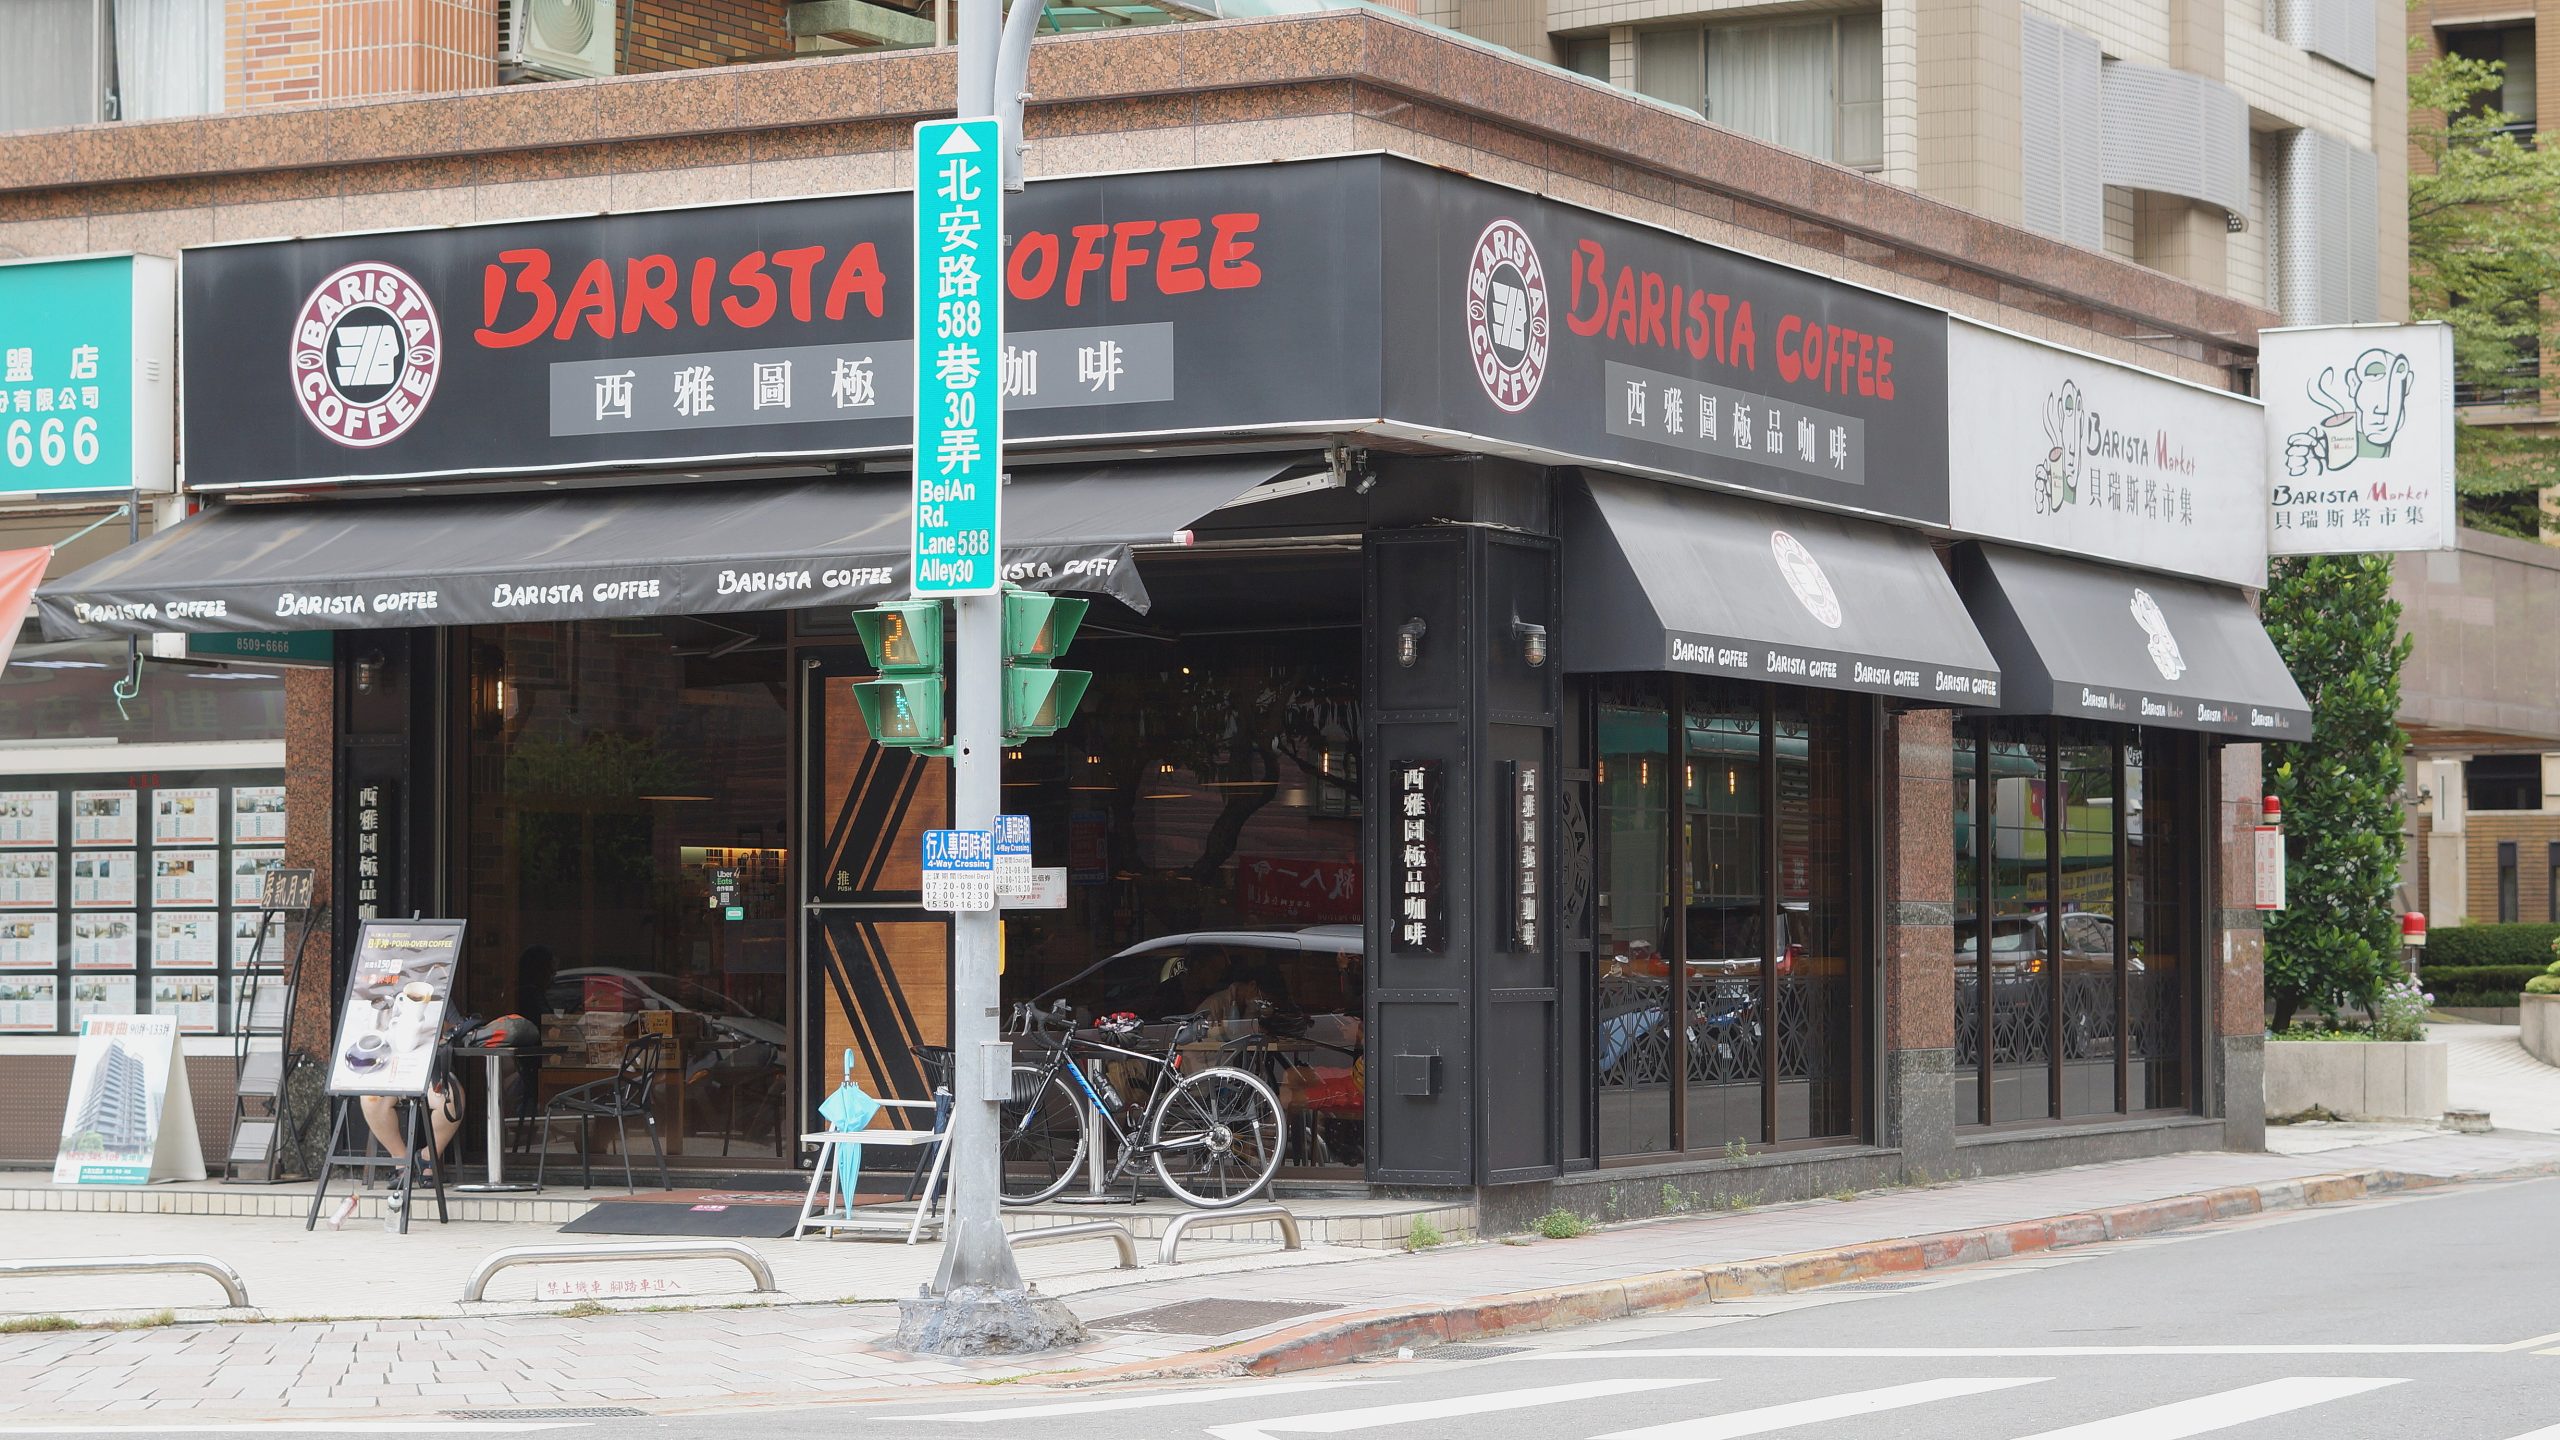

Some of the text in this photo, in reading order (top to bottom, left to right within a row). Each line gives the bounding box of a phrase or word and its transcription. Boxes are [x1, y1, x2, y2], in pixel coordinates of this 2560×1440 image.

[474, 213, 1262, 349] BARISTA OFFEE
[1474, 230, 1544, 316] BARISTA
[303, 272, 433, 344] BARISTA
[1566, 239, 1895, 400] BARISTA COFFEE
[1473, 325, 1545, 403] COFFEE
[594, 340, 1125, 421] 西雅圖極咖啡
[301, 365, 432, 438] COFFEE
[1626, 380, 1848, 471] 西雅圖極品咖啡
[6, 416, 100, 468] 666
[2087, 412, 2195, 477] BARISTA Market
[920, 478, 976, 503] BeiAn
[2089, 467, 2192, 527] 貝瑞斯塔市集
[2271, 481, 2429, 506] BARISTA Market
[919, 504, 949, 528] Rd.
[2274, 505, 2424, 530] 貝瑞斯塔市集
[919, 529, 990, 556] Lane 588
[492, 579, 661, 608] BARISTA COFFEE
[716, 566, 893, 595] BARISTA COFFEE
[75, 599, 227, 625] BARISTA COFFEE
[275, 590, 439, 617] BARISTA COFFEE
[236, 637, 289, 653] 8509-6666
[1672, 638, 1748, 668] BARISTA COFFEE
[1766, 651, 1837, 679] BARISTA COFFEE
[1854, 662, 1920, 687] BARISTA COFFEE
[1935, 671, 1997, 696] BARISTA COFFEE
[926, 832, 991, 860] 行人專用時相
[1403, 767, 1427, 946] 西雅圖極品咖啡
[837, 870, 850, 885] 推
[927, 860, 990, 869] 4-Way Crossing
[547, 1279, 681, 1295] 禁止機車 腳踏車進入
